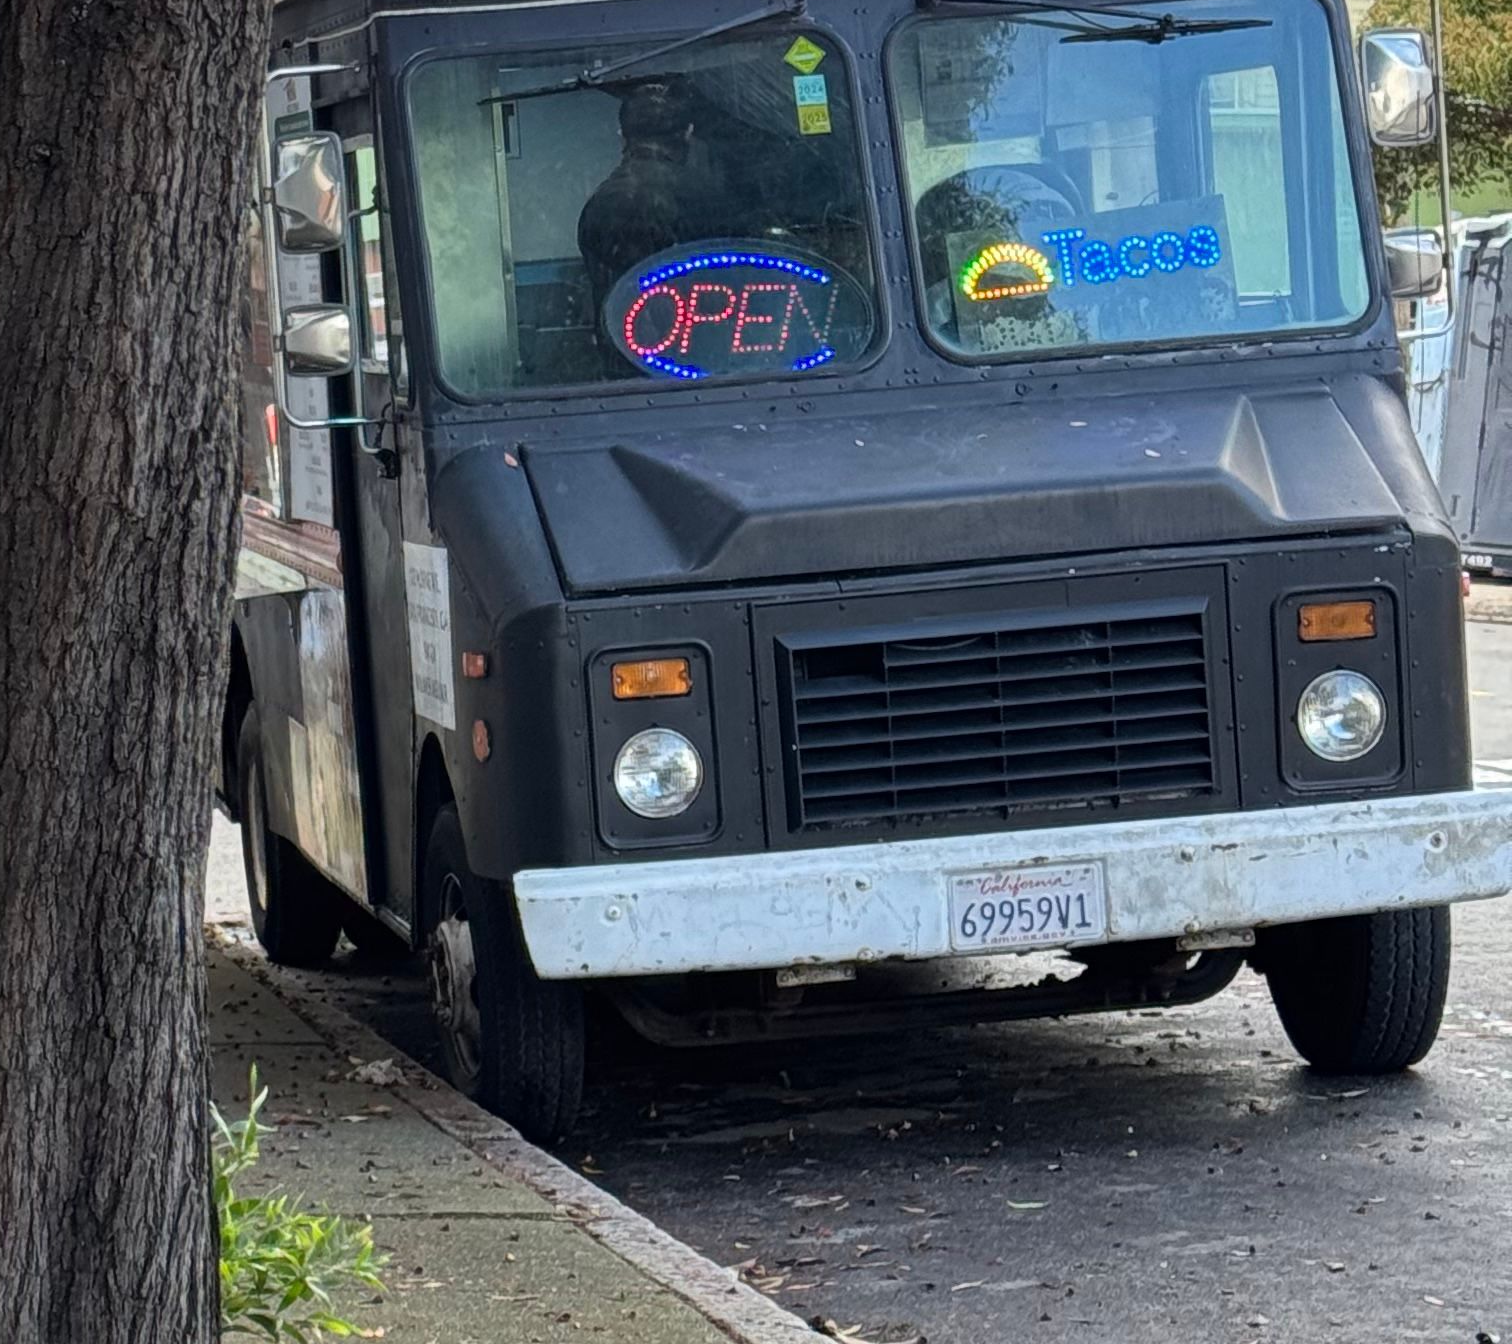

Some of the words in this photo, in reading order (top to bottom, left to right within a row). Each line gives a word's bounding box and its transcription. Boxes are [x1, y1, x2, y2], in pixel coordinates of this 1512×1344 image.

[1042, 225, 1220, 288] Tacos
[623, 283, 839, 356] OPEN
[979, 873, 1071, 897] California
[961, 893, 1091, 938] 69959V1
